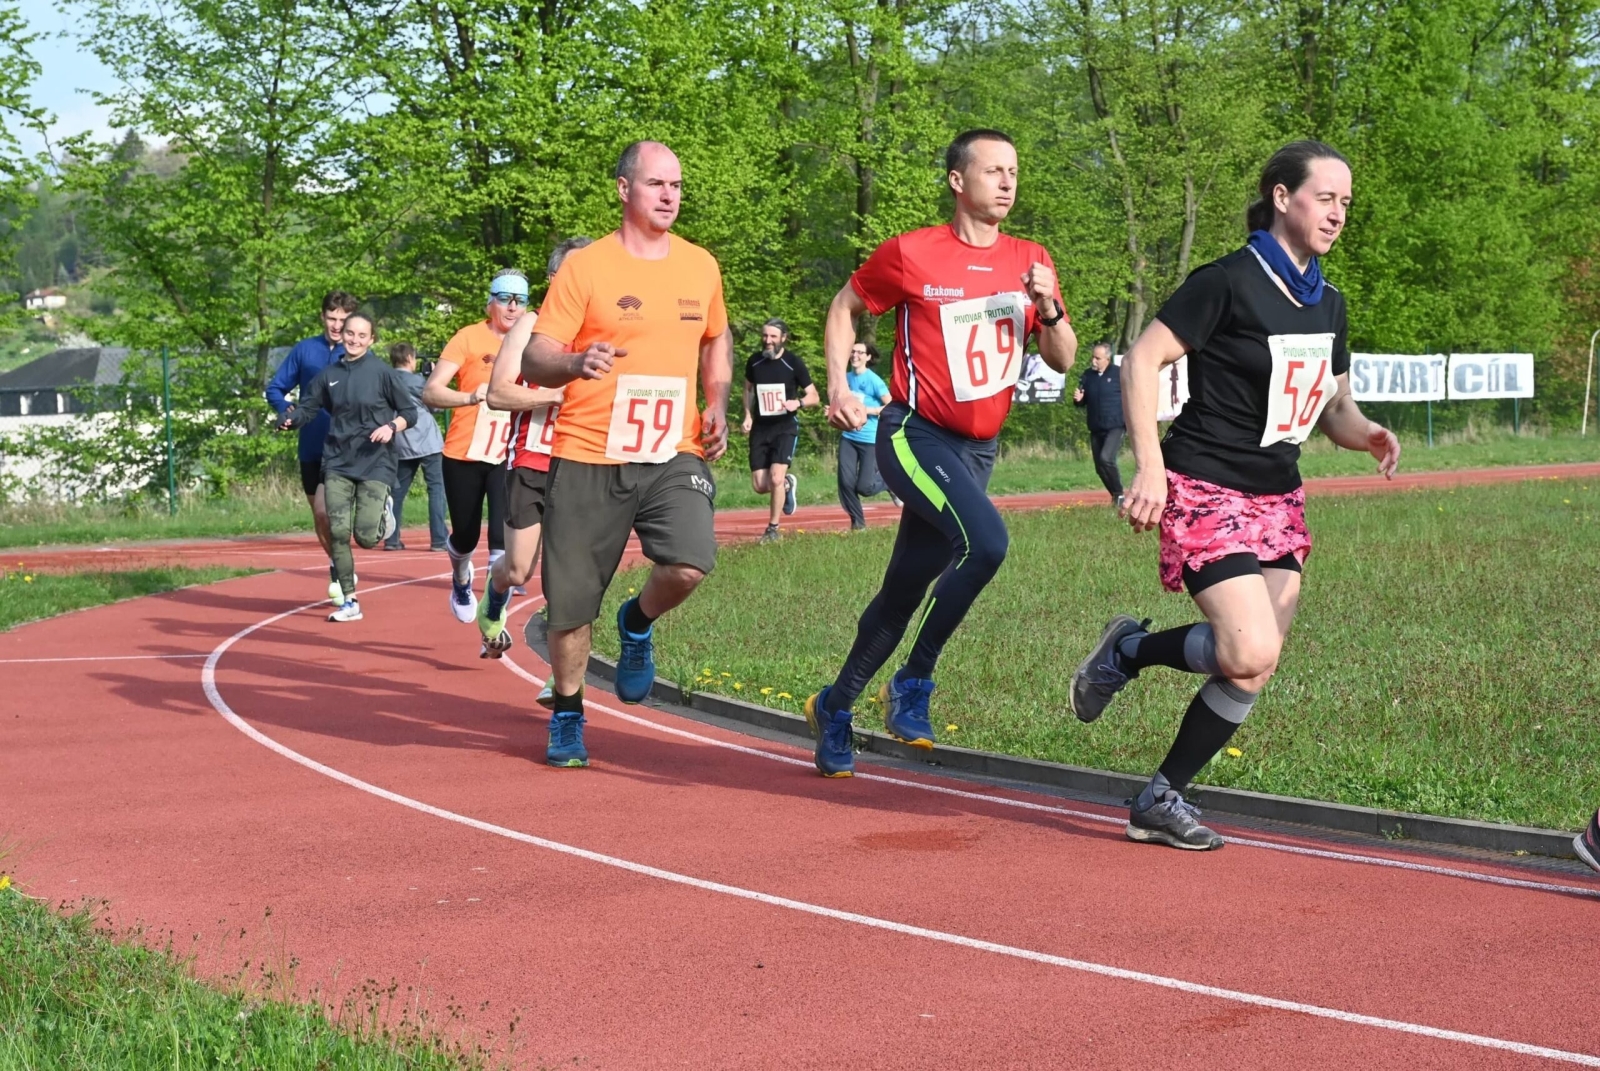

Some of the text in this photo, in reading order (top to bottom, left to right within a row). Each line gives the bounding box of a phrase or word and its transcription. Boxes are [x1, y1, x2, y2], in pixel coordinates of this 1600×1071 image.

[954, 305, 1014, 324] PIVOVAR TRUTNOV
[966, 317, 1014, 387] 69
[1283, 347, 1307, 358] PIVOVAR
[1353, 359, 1443, 394] START
[1453, 358, 1523, 393] CÍL
[627, 389, 680, 398] PIVOVAR TRUTNOV
[761, 391, 784, 412] 105
[1277, 360, 1327, 432] 56
[622, 398, 673, 453] 59
